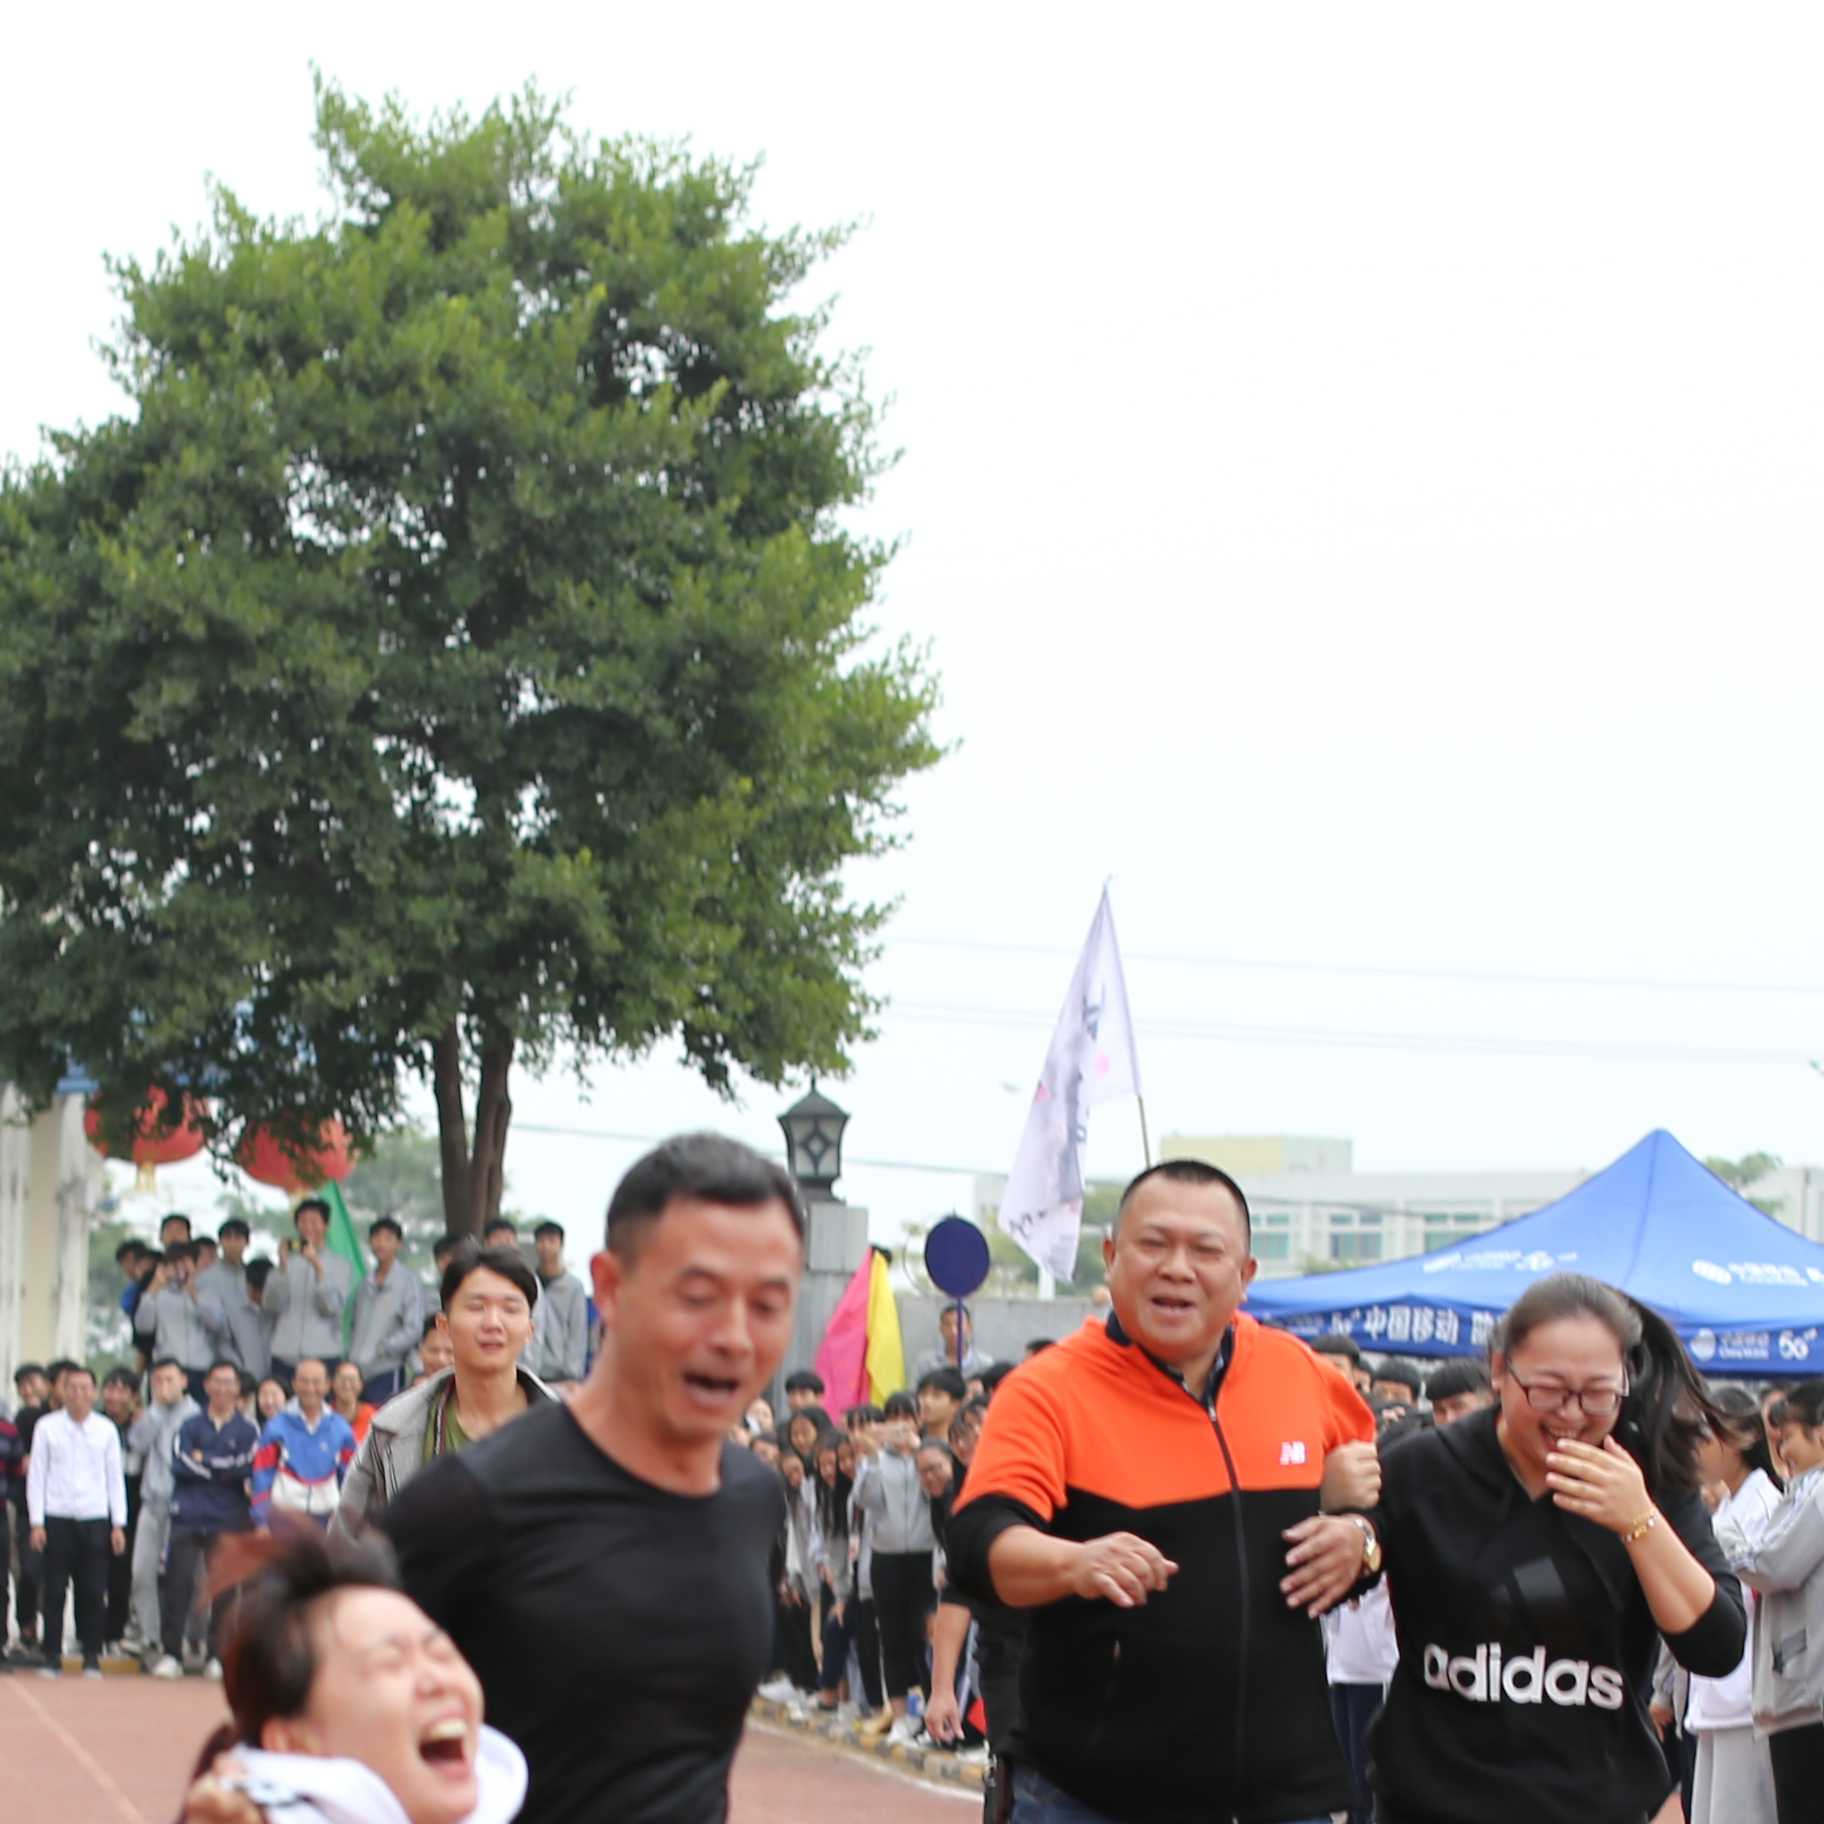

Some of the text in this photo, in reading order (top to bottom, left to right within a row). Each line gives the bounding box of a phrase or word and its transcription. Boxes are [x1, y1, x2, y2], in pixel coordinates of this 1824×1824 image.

[1364, 1305, 1459, 1345] 中国移动
[1424, 1642, 1624, 1710] adidas
